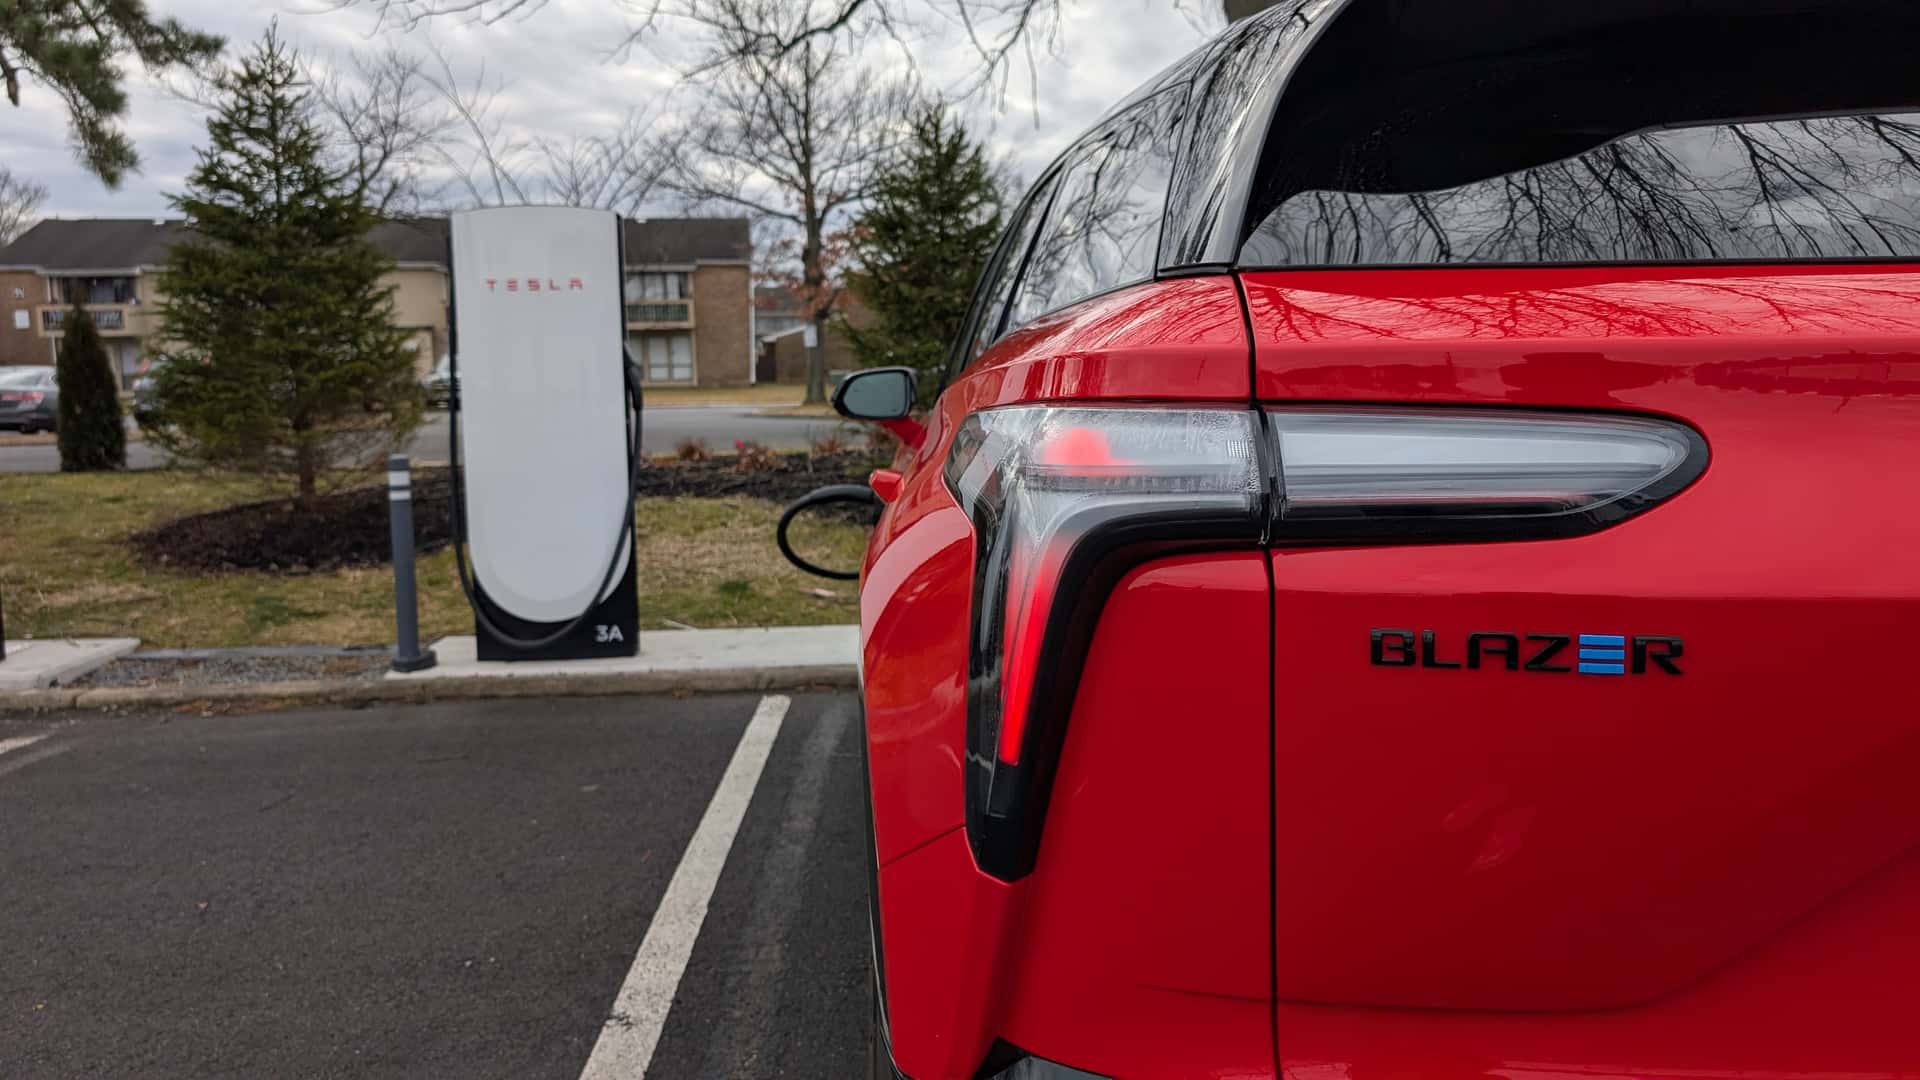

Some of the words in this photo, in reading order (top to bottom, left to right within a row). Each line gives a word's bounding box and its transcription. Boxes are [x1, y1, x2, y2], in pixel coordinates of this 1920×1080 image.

[485, 278, 583, 292] TESLA
[595, 624, 624, 642] 3A
[1370, 628, 1684, 676] BLAZER
